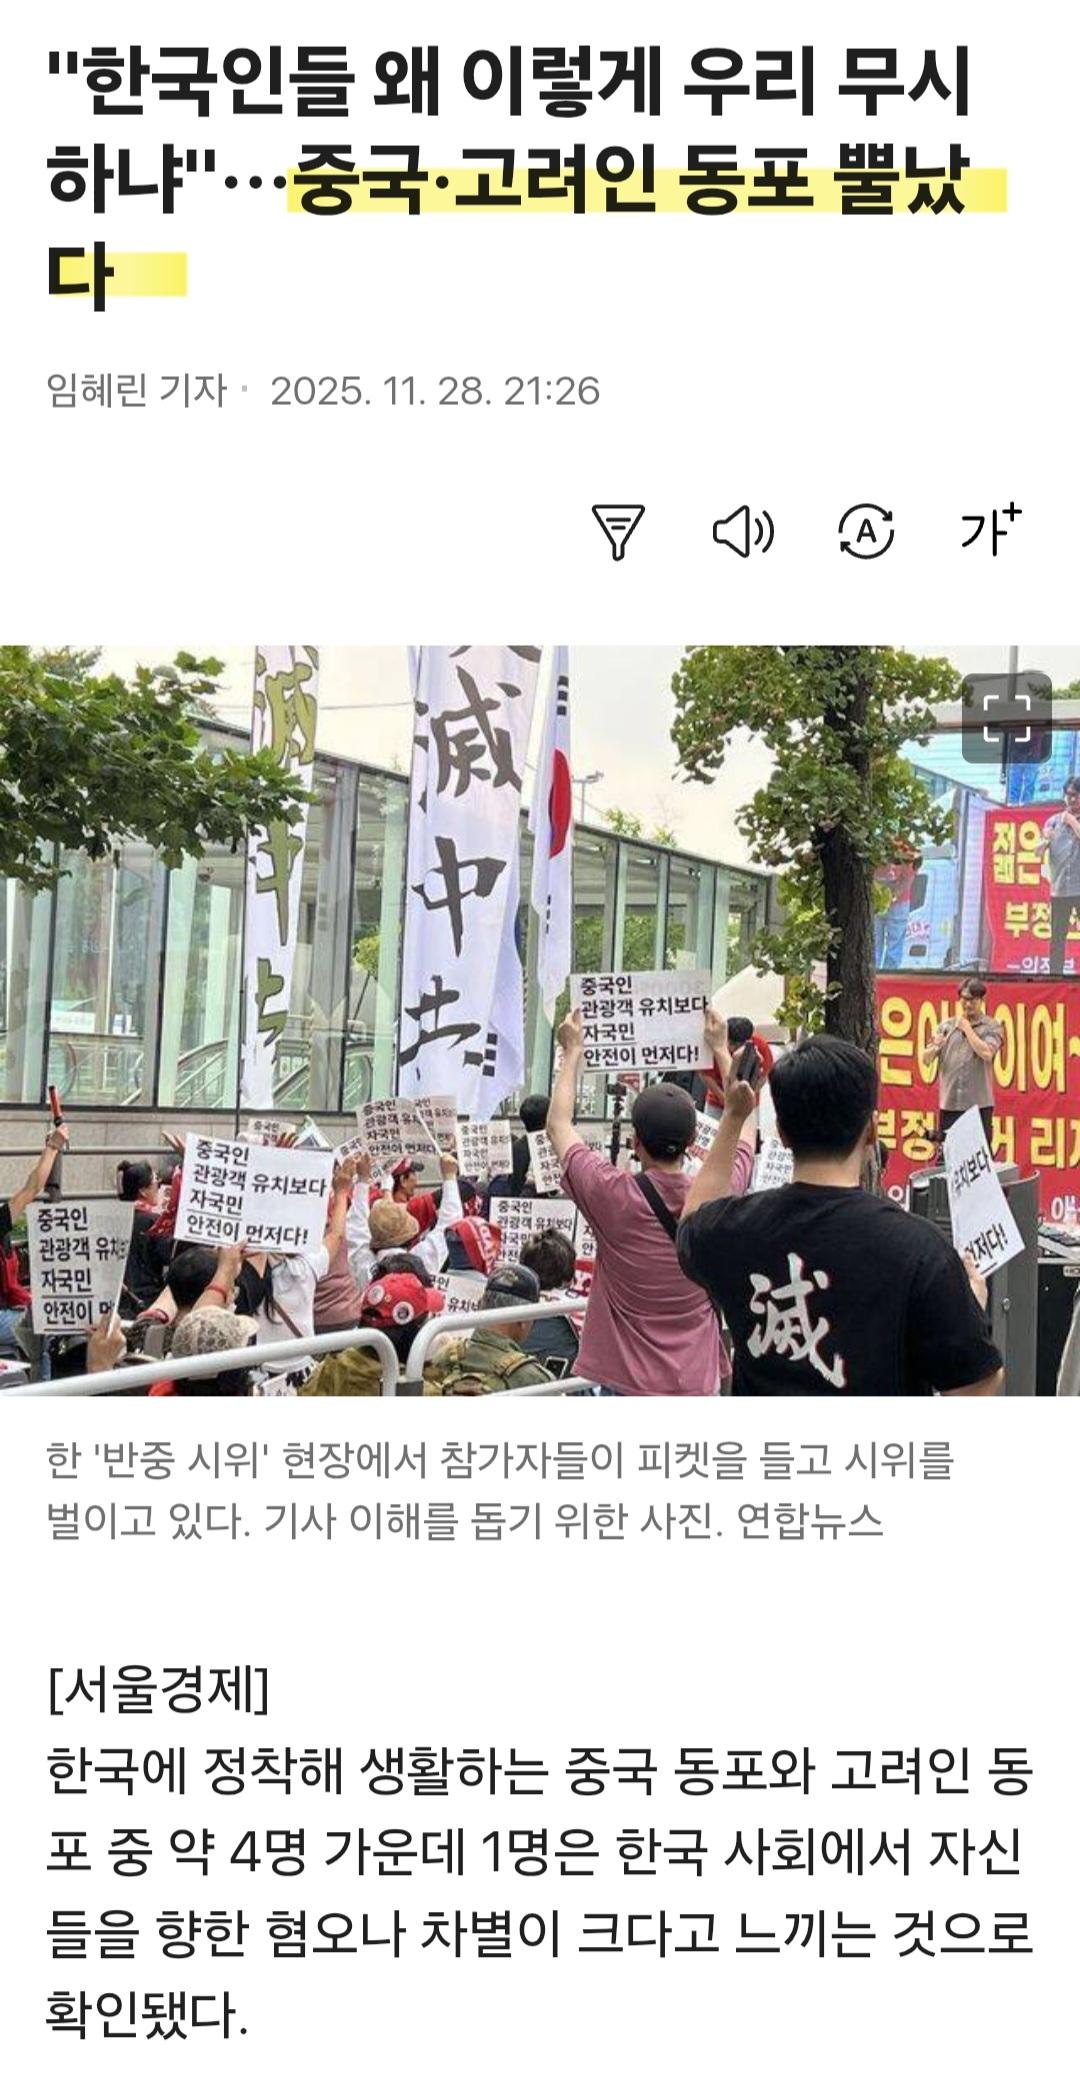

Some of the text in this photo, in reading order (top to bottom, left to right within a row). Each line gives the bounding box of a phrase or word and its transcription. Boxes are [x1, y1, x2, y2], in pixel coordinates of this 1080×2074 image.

[580, 976, 632, 996] 중국인
[581, 995, 709, 1019] 관광객 유치보다
[583, 1022, 635, 1042] 자국민
[583, 1044, 699, 1067] 안전이 먼저다!
[196, 1138, 248, 1168] 중국인
[193, 1163, 327, 1198] 관광객 유치보다
[189, 1188, 243, 1216] 자국민
[497, 1200, 532, 1214] 중국인
[37, 1206, 88, 1232] 중국인
[186, 1215, 308, 1247] 안전이 먼저다!
[39, 1237, 90, 1262] 관광객
[41, 1268, 92, 1293] 자국민
[43, 1300, 93, 1325] 안전이
[747, 1251, 846, 1390] 滅
